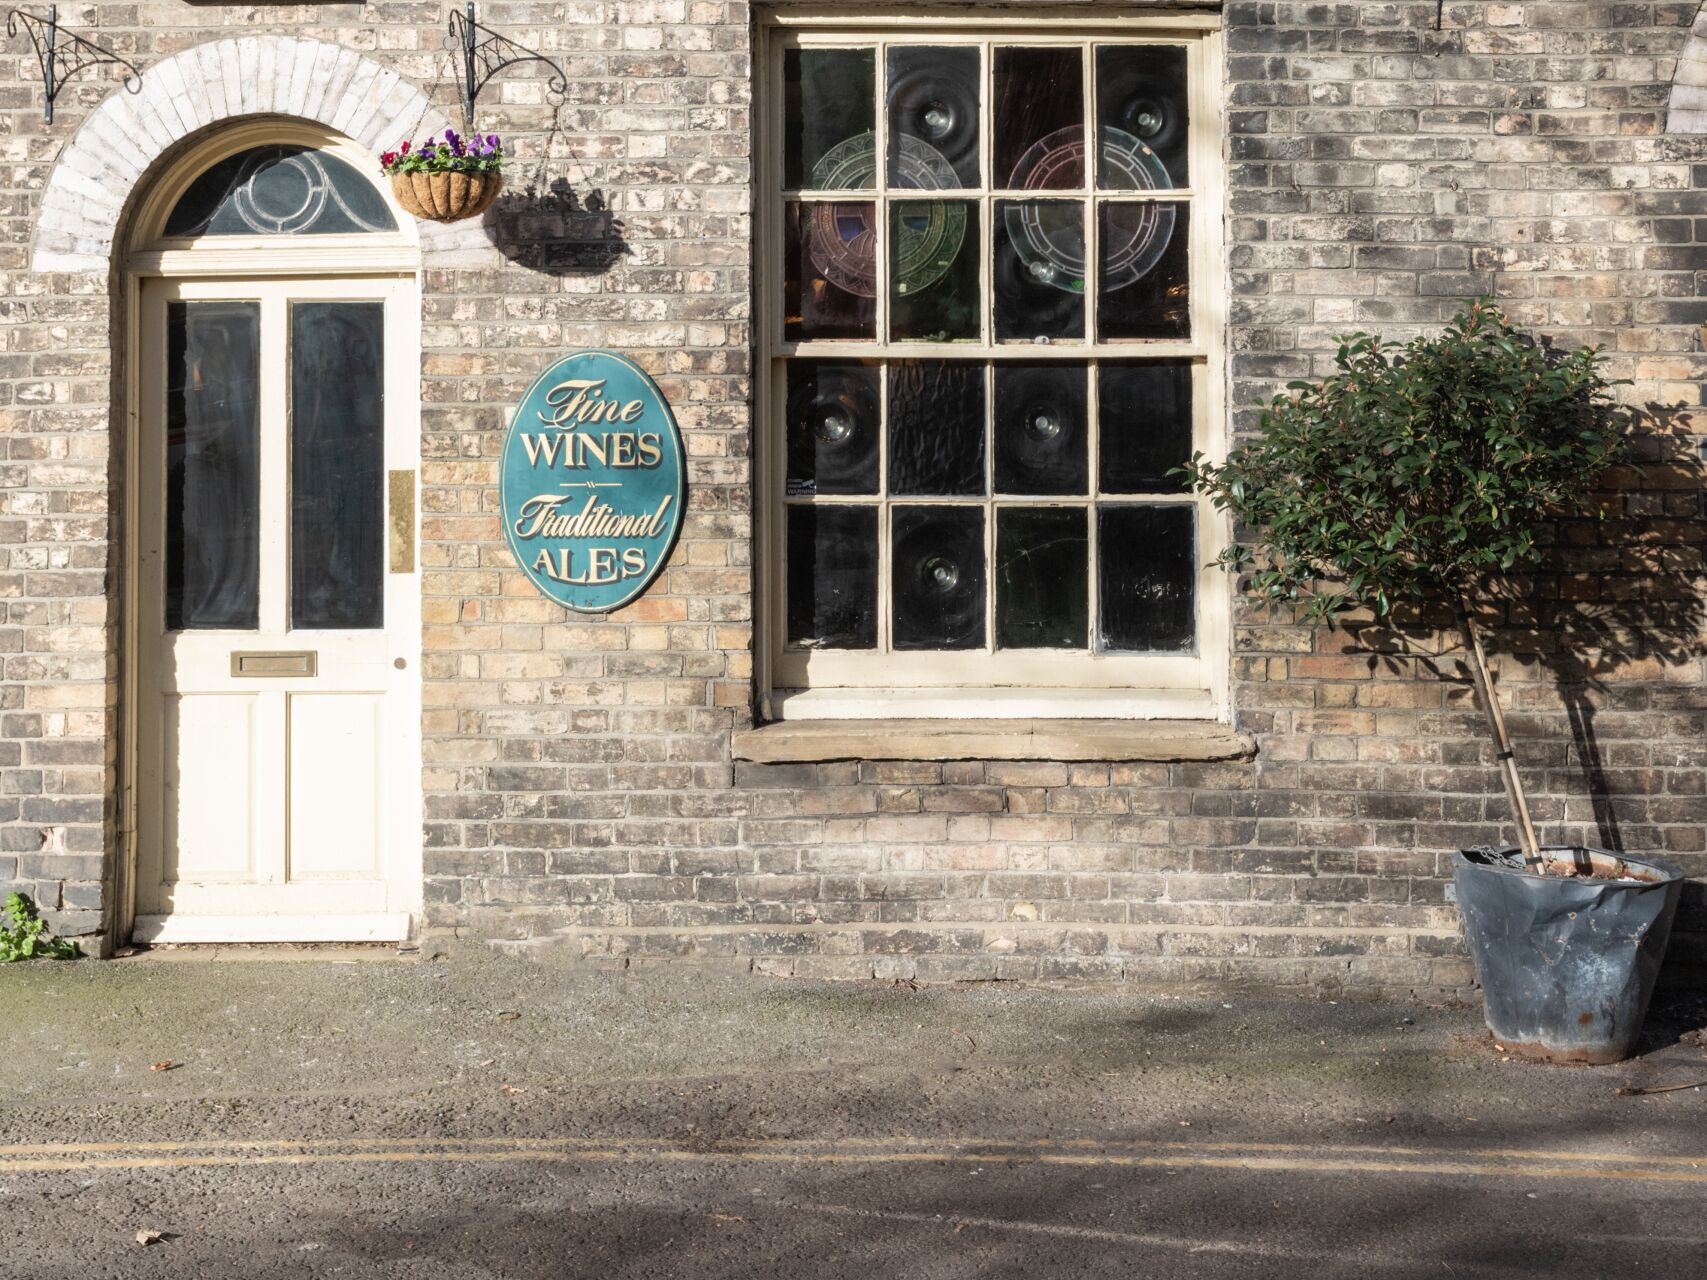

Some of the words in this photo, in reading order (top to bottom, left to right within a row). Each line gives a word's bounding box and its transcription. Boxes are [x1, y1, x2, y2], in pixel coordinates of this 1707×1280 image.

[537, 379, 643, 429] Fine
[520, 432, 662, 467] WINES
[515, 494, 673, 538] Traditional
[532, 548, 646, 585] ALES
